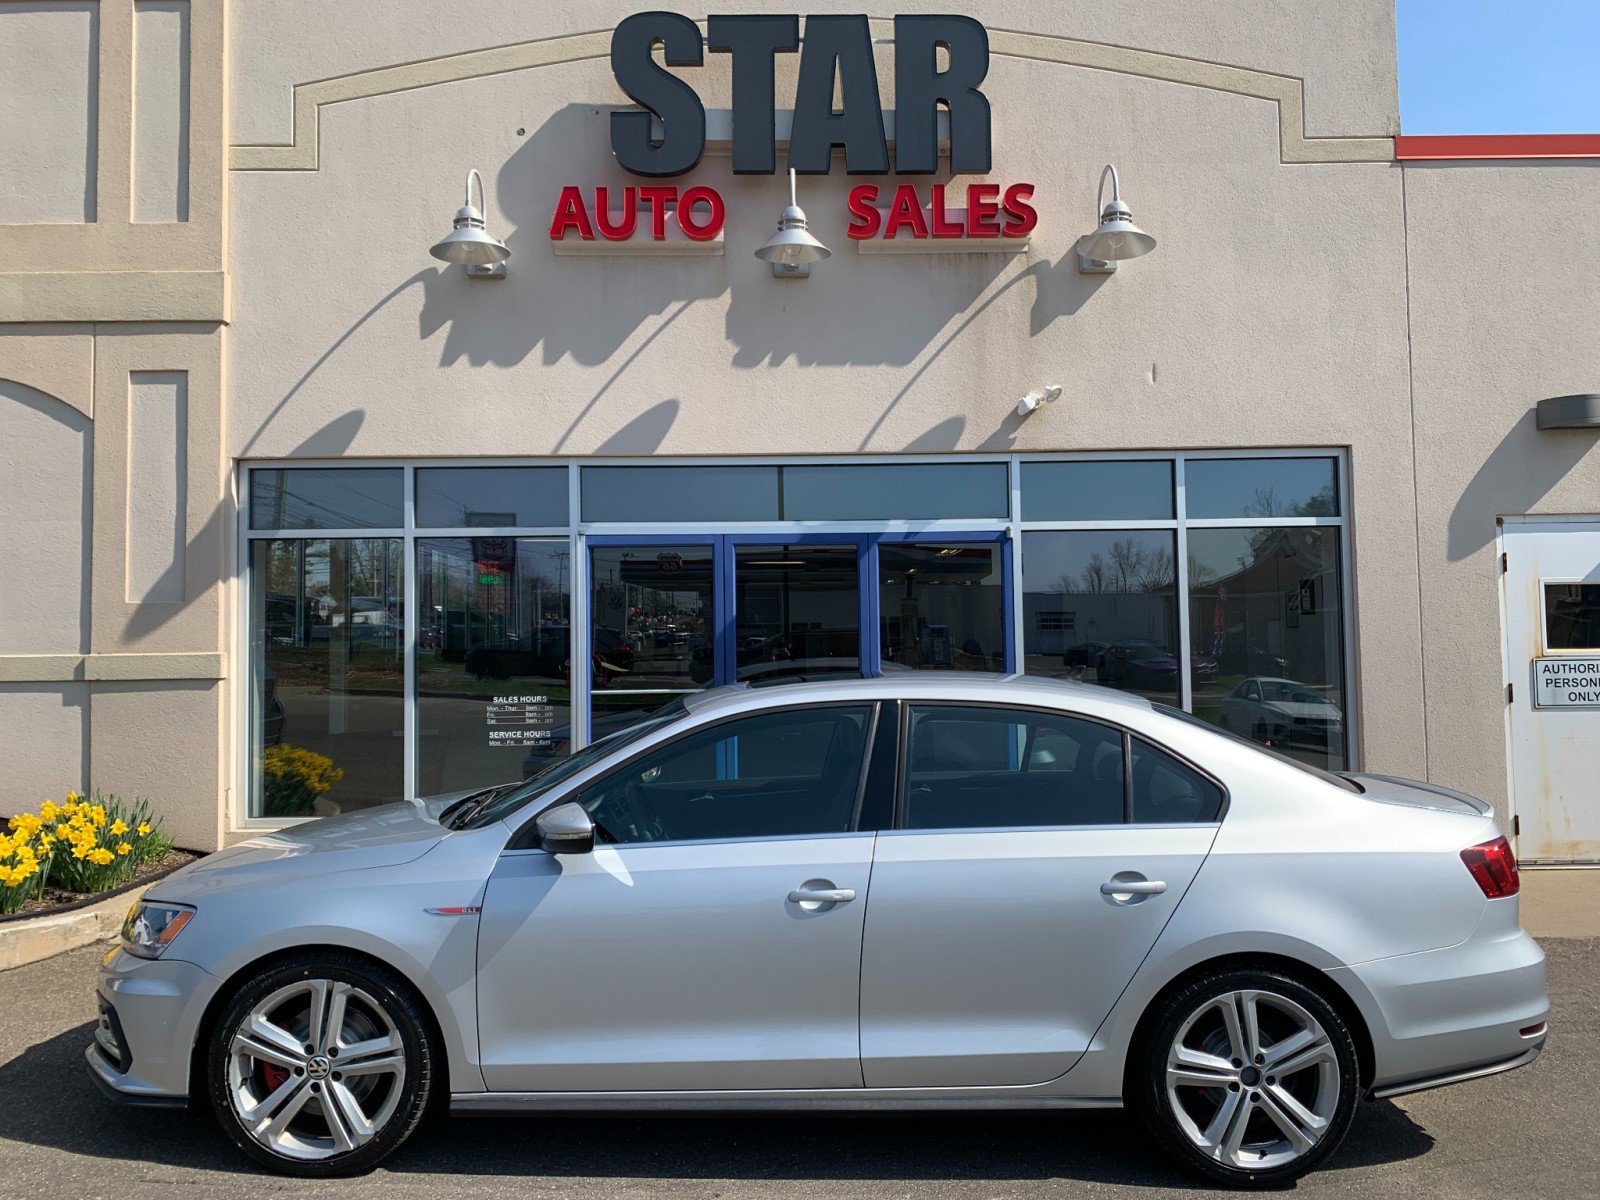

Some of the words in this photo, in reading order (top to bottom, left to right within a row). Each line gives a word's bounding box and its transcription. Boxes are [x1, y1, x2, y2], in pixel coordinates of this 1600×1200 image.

[611, 11, 991, 176] STAR
[550, 186, 725, 241] AUTO
[847, 183, 1038, 239] SALES
[1542, 664, 1600, 674] AUTHORI
[1545, 677, 1600, 688] PERSON
[1568, 691, 1600, 702] ONLY
